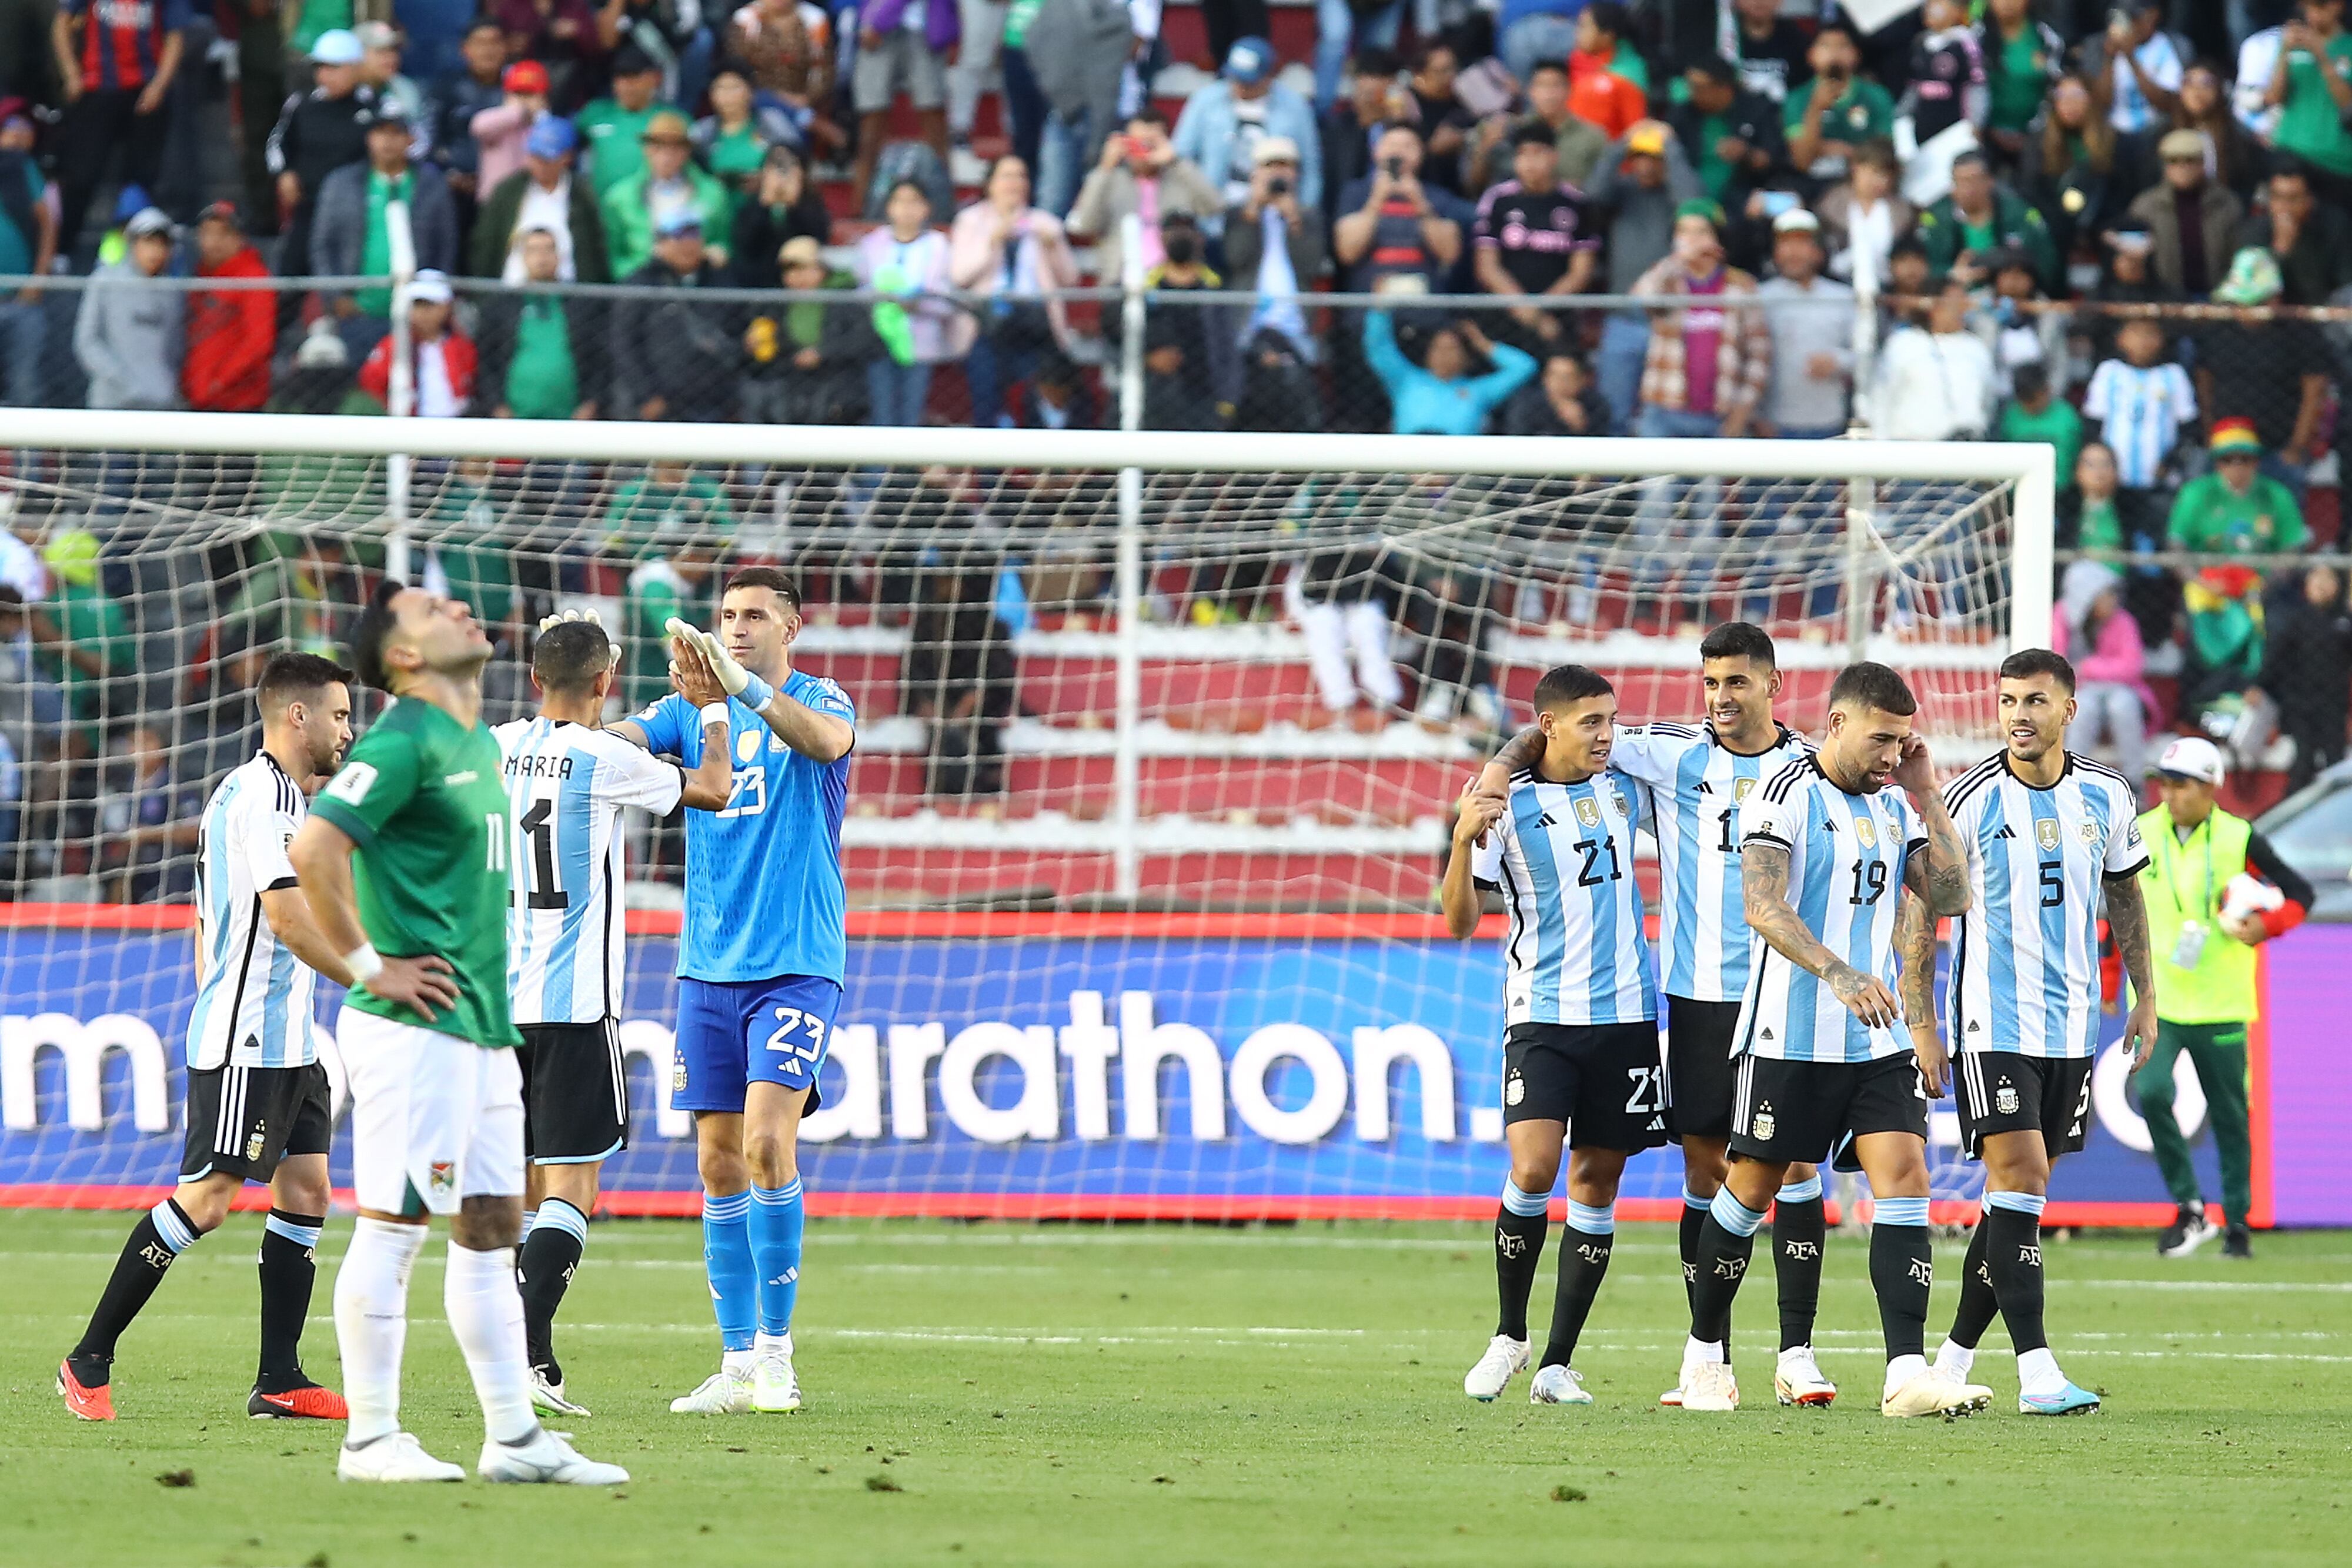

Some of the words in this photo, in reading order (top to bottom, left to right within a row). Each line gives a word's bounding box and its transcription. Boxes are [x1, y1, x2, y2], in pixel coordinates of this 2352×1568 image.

[505, 755, 573, 781] MARIA
[485, 813, 505, 872] 11
[508, 798, 569, 909] 1
[1718, 810, 1742, 854] 1
[1573, 835, 1622, 887] 21
[1849, 858, 1887, 905] 19
[2039, 861, 2064, 907] 5
[766, 1007, 824, 1063] 23
[1625, 1065, 1666, 1114] 21
[139, 1241, 172, 1268] AFA
[1498, 1227, 1526, 1259] AFA
[1786, 1240, 1819, 1261] AFA
[1714, 1257, 1746, 1280] AFA
